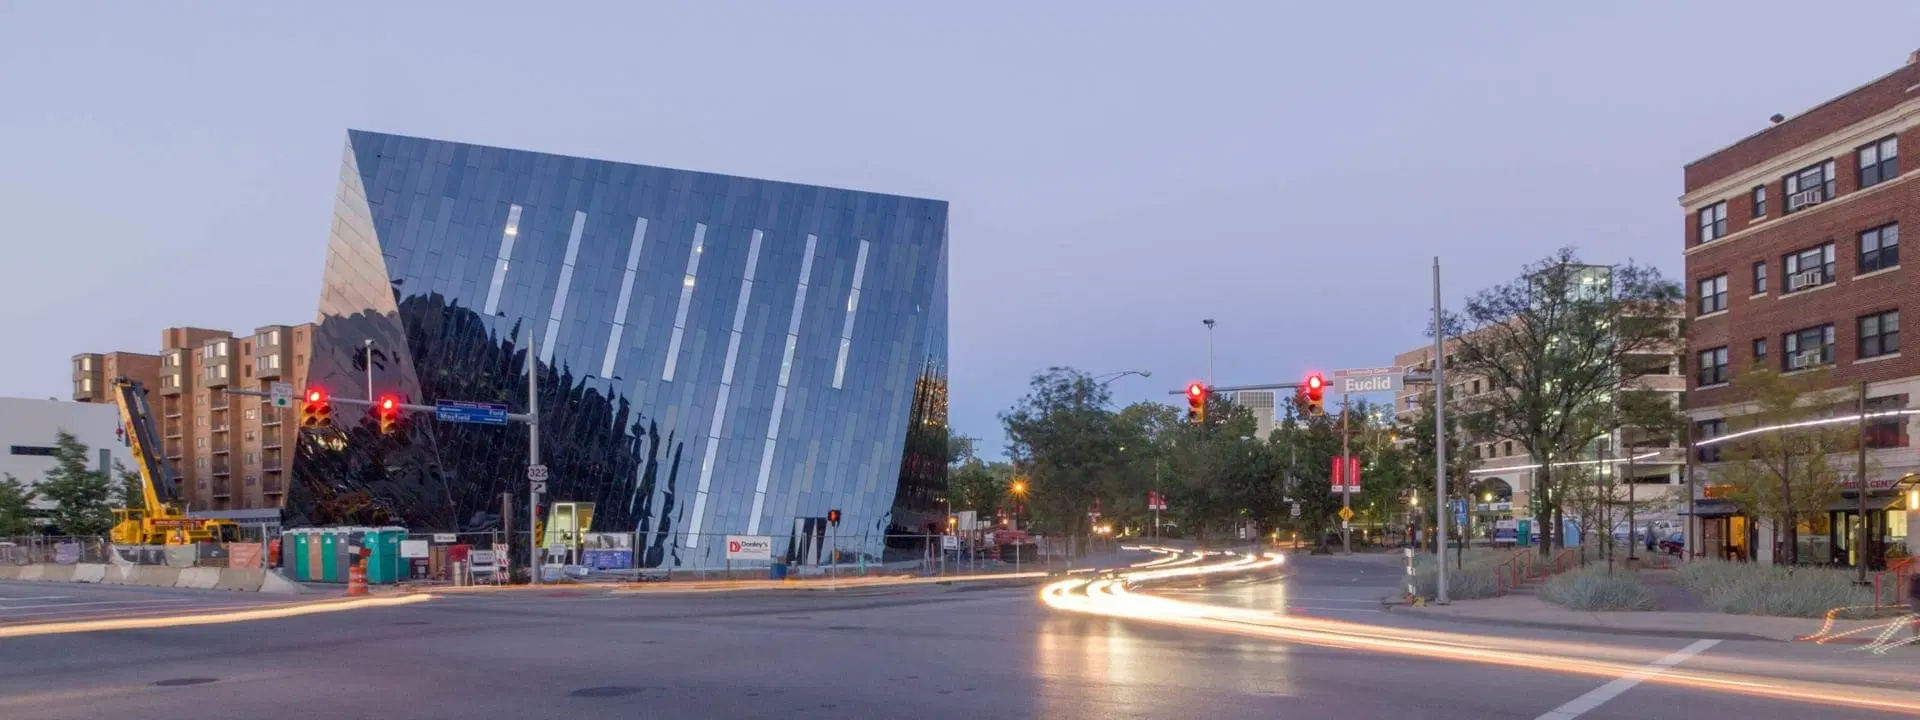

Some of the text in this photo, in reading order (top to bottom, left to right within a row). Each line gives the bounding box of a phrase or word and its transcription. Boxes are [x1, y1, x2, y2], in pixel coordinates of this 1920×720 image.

[1345, 377, 1391, 391] Euclid
[440, 411, 471, 422] Mayfield
[530, 467, 546, 478] 322
[741, 540, 769, 549] Donley's
